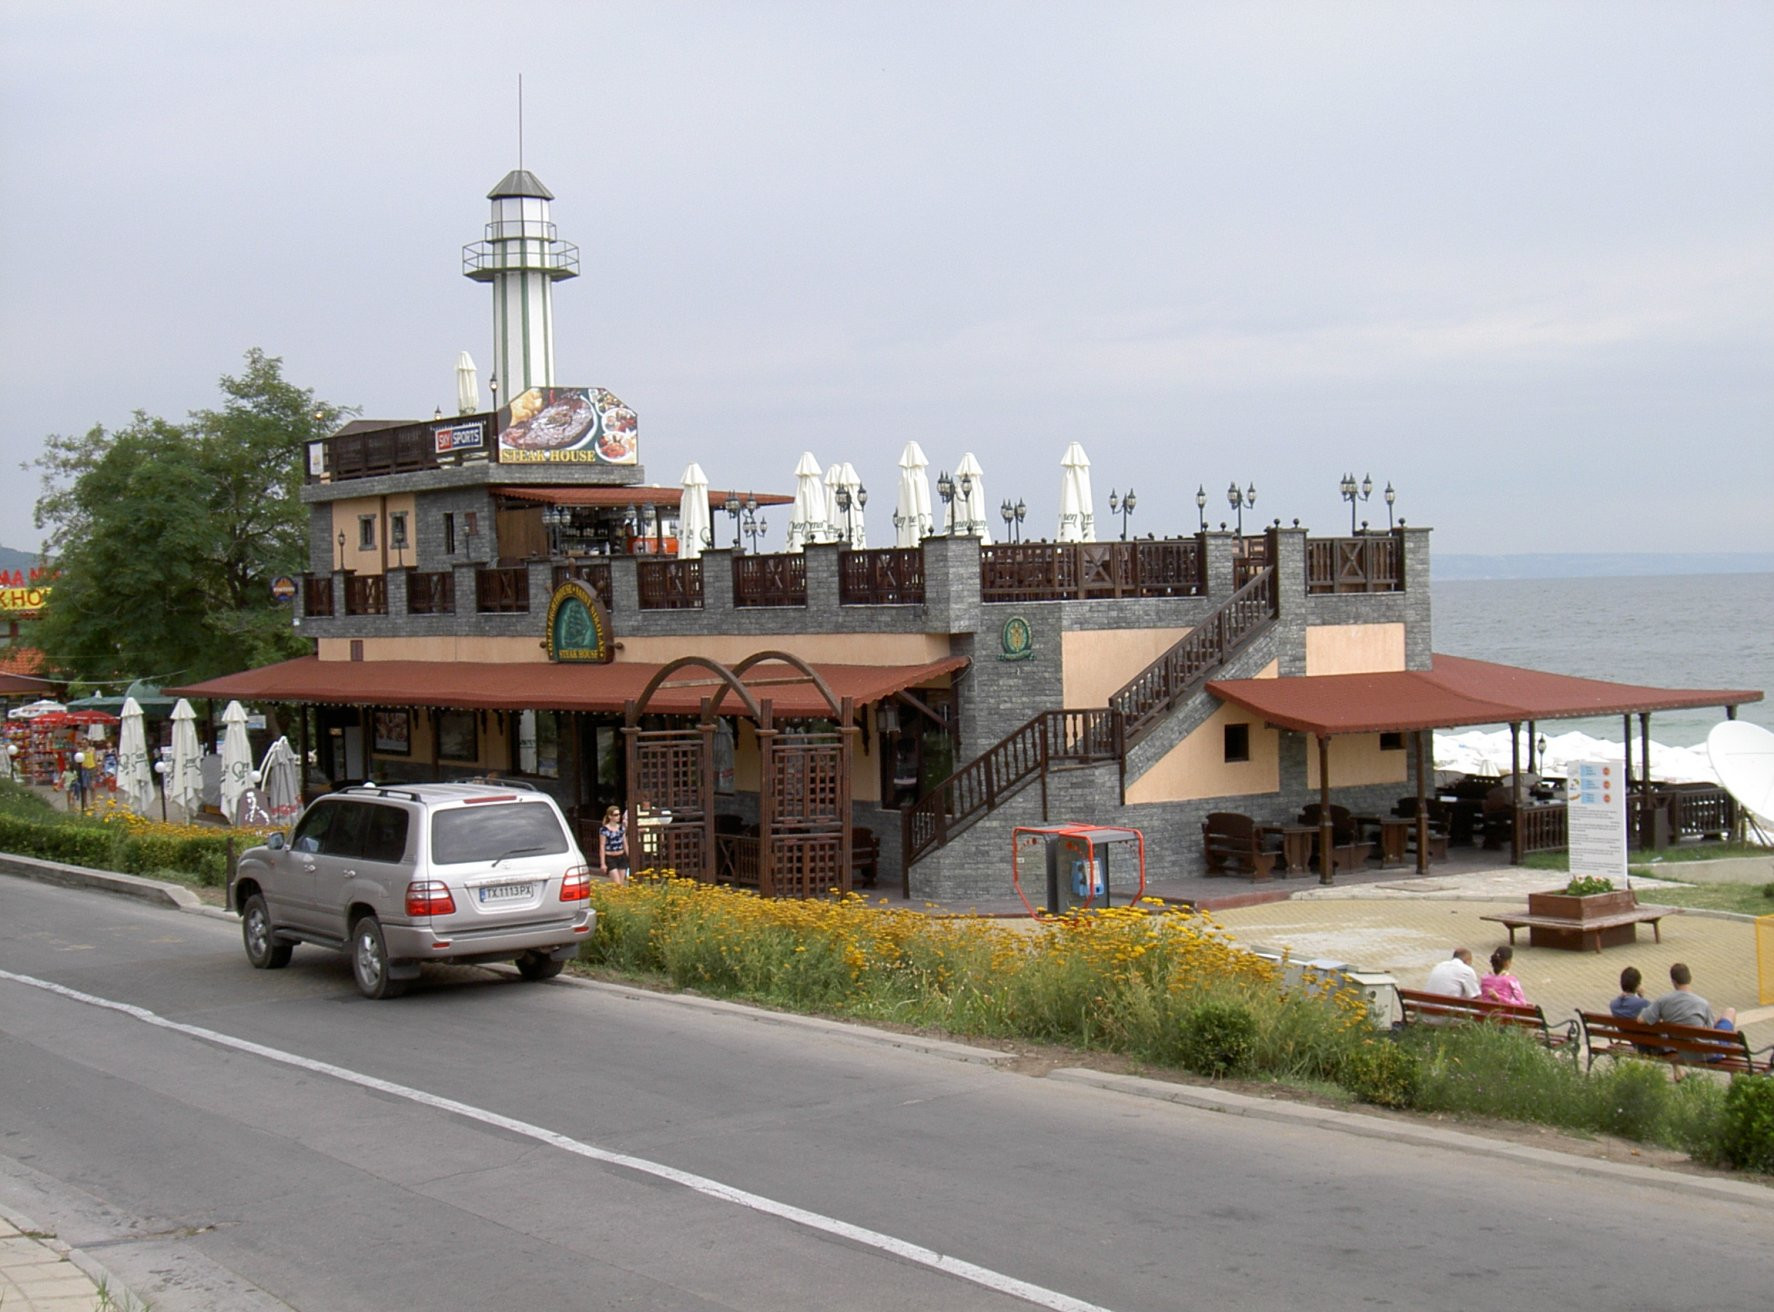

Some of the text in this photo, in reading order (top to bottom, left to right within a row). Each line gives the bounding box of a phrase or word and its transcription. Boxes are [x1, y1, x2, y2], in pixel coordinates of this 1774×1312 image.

[438, 429, 480, 449] SKY SPORTS
[502, 449, 596, 463] STEAK HOUSE
[0, 589, 48, 608] KHO
